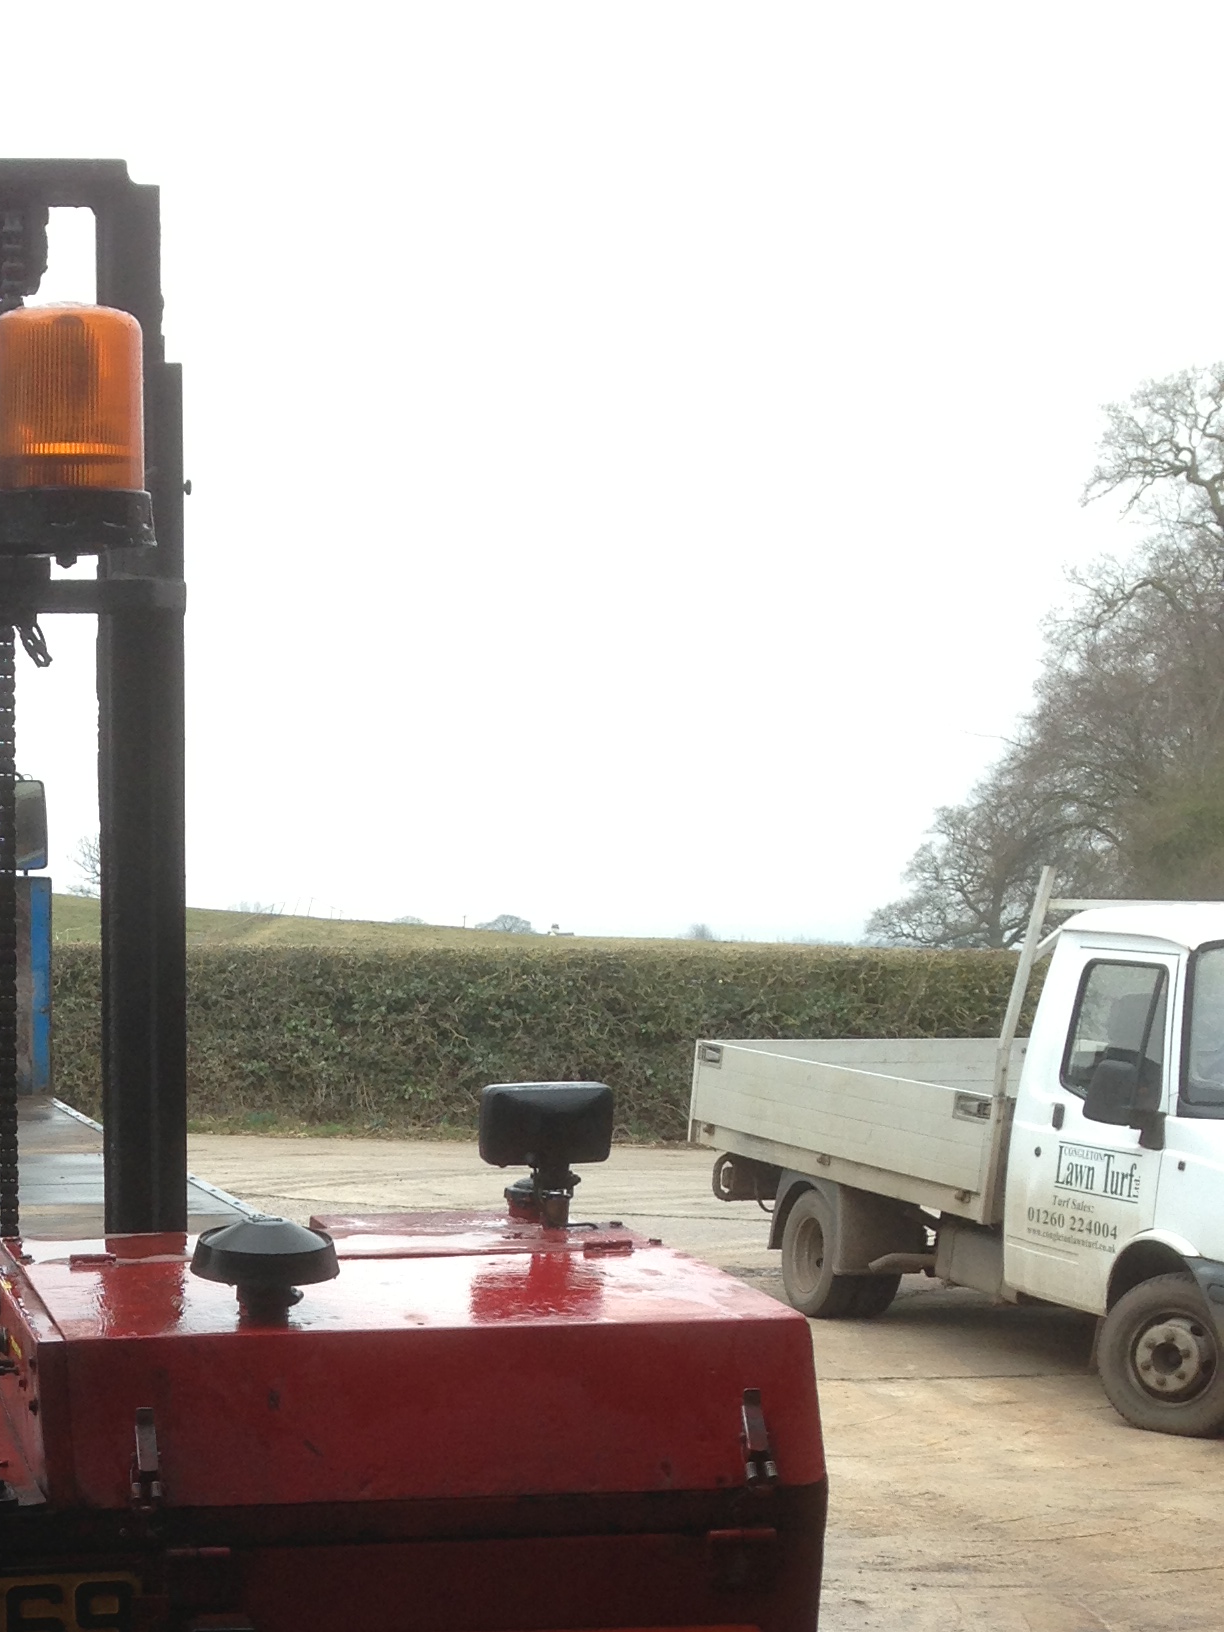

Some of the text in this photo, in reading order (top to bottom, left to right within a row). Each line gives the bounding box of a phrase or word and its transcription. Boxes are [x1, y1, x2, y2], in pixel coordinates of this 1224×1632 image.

[1063, 1146, 1104, 1161] CONGLETON
[1054, 1145, 1137, 1198] Lawn Turf
[1053, 1195, 1095, 1214] Turf Sales:
[1027, 1206, 1118, 1240] 01260 224004
